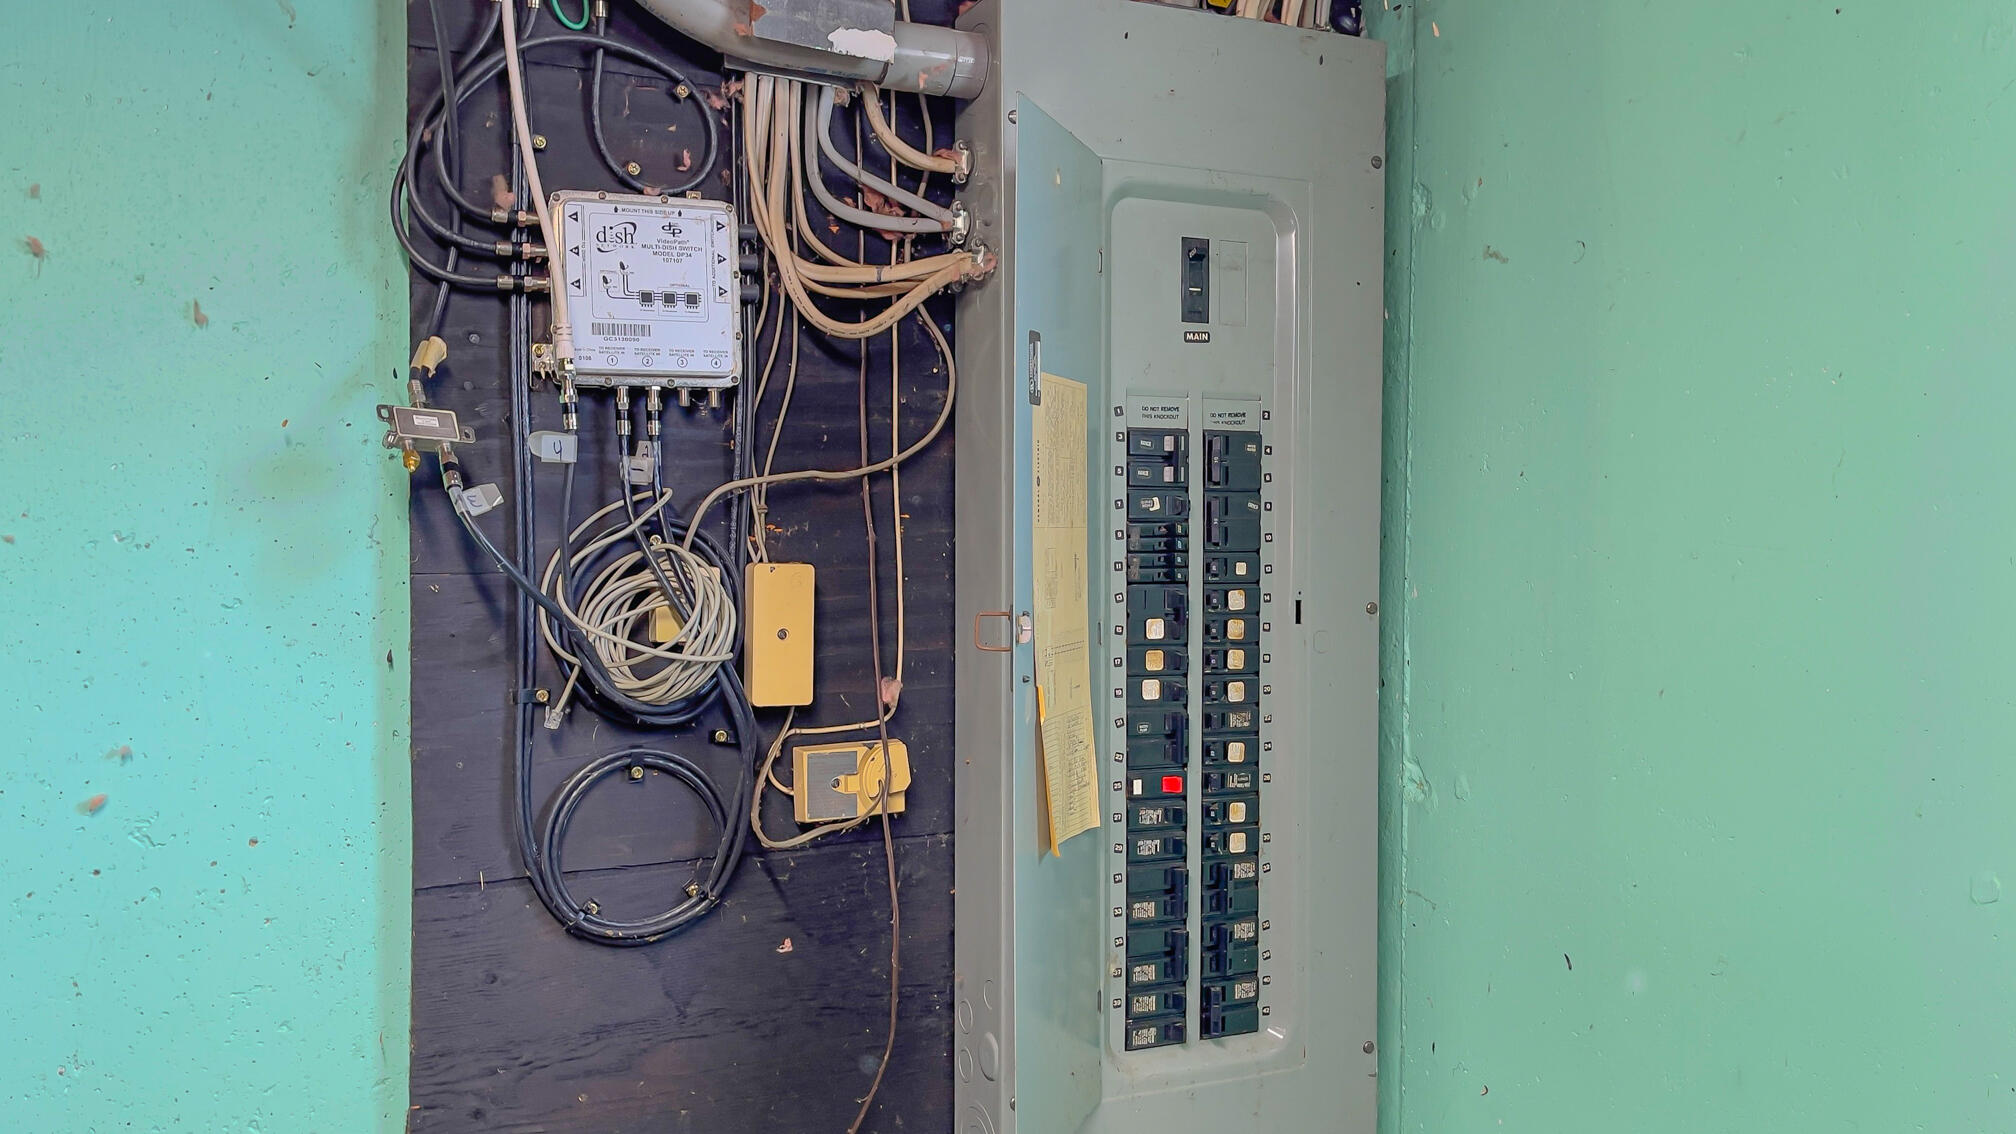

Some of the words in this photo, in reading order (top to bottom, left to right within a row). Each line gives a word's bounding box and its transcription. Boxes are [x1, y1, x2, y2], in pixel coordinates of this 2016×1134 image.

[596, 224, 635, 245] dish
[652, 250, 675, 258] MODEL
[1186, 332, 1209, 341] MAIN
